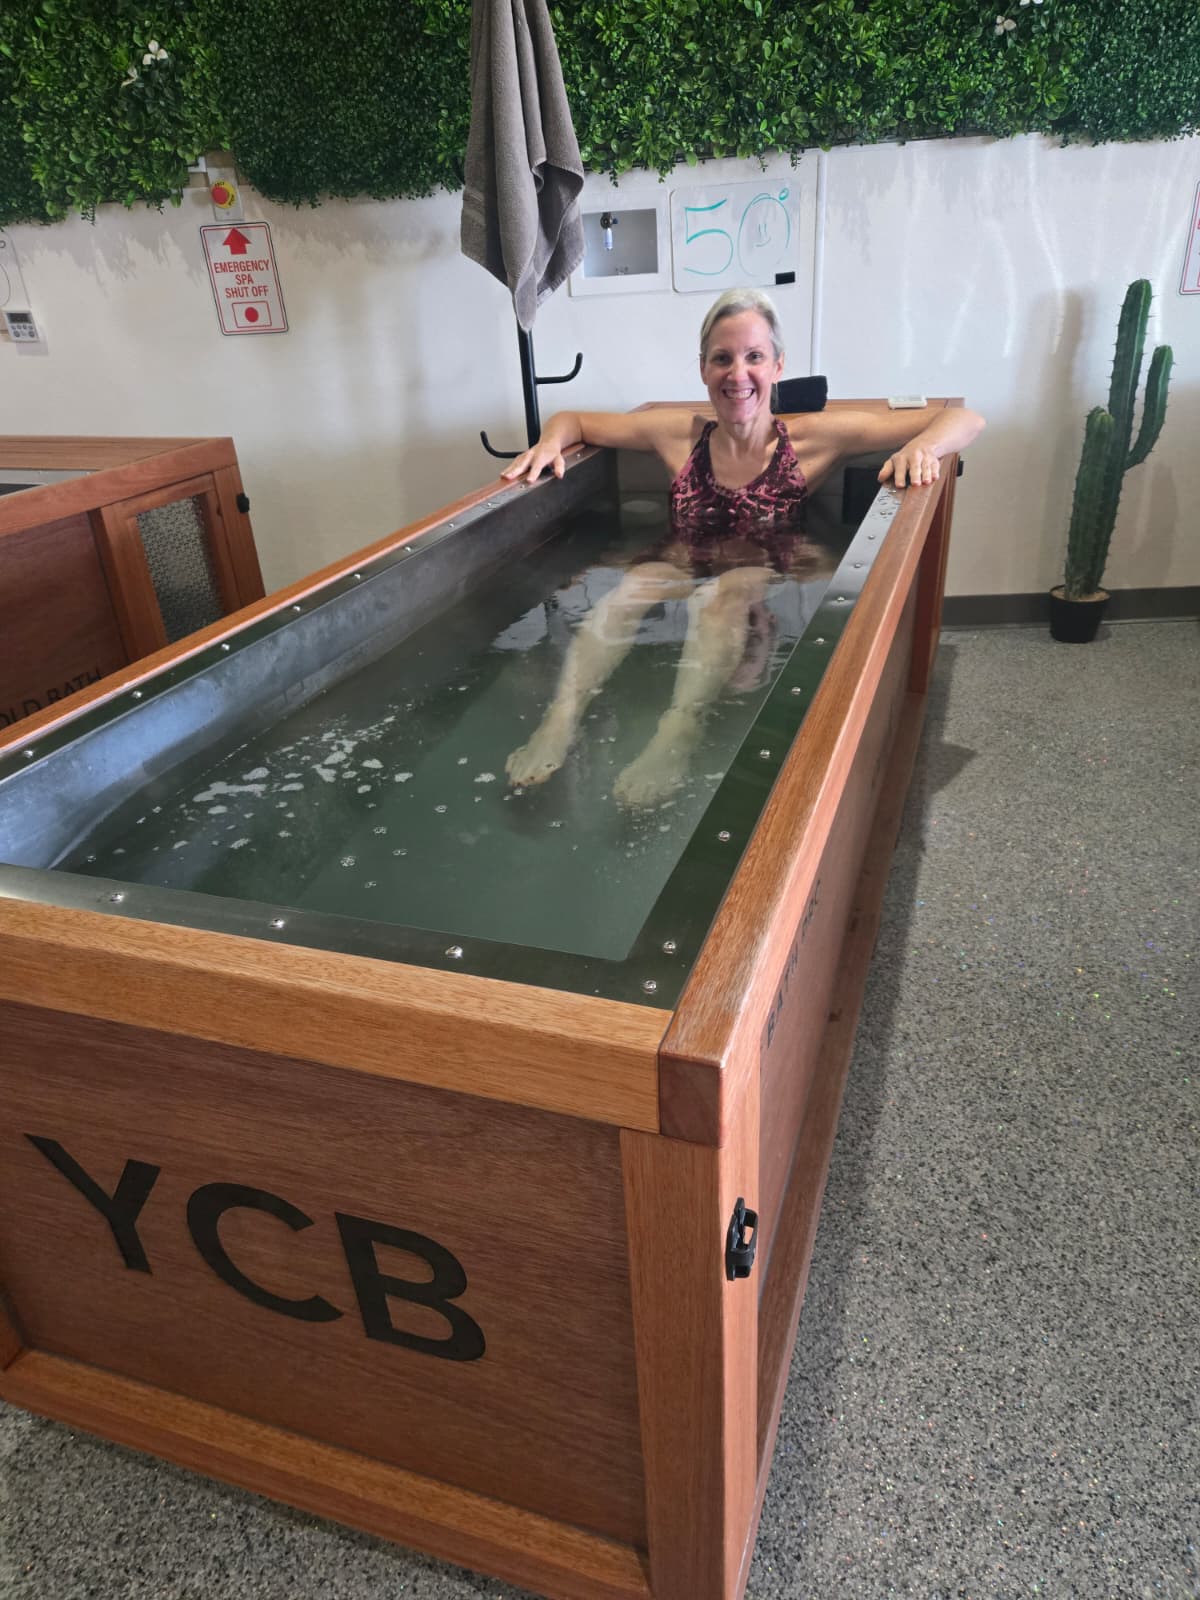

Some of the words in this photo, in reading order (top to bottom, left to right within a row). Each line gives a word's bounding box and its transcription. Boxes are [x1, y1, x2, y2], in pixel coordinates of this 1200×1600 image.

[213, 259, 270, 274] EMERGENCY
[235, 273, 254, 286] SPA
[225, 286, 250, 299] SHUT
[251, 285, 269, 297] OFF
[23, 1132, 487, 1363] YCB
